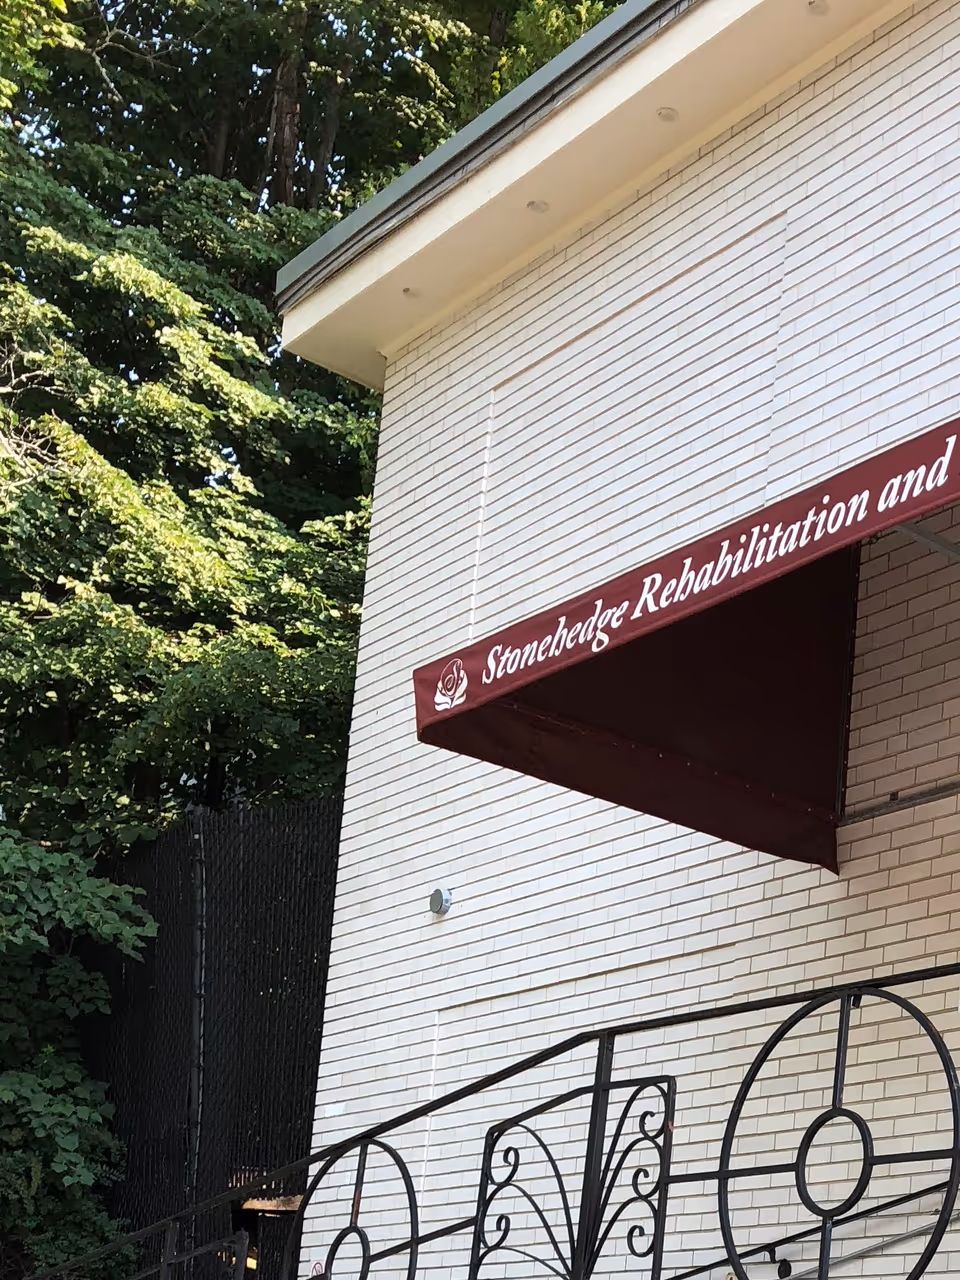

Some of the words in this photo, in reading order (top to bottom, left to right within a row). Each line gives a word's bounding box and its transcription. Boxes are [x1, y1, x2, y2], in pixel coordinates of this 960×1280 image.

[482, 599, 630, 684] Stonehedge
[631, 490, 870, 620] Rehabilitation
[878, 435, 957, 512] and
